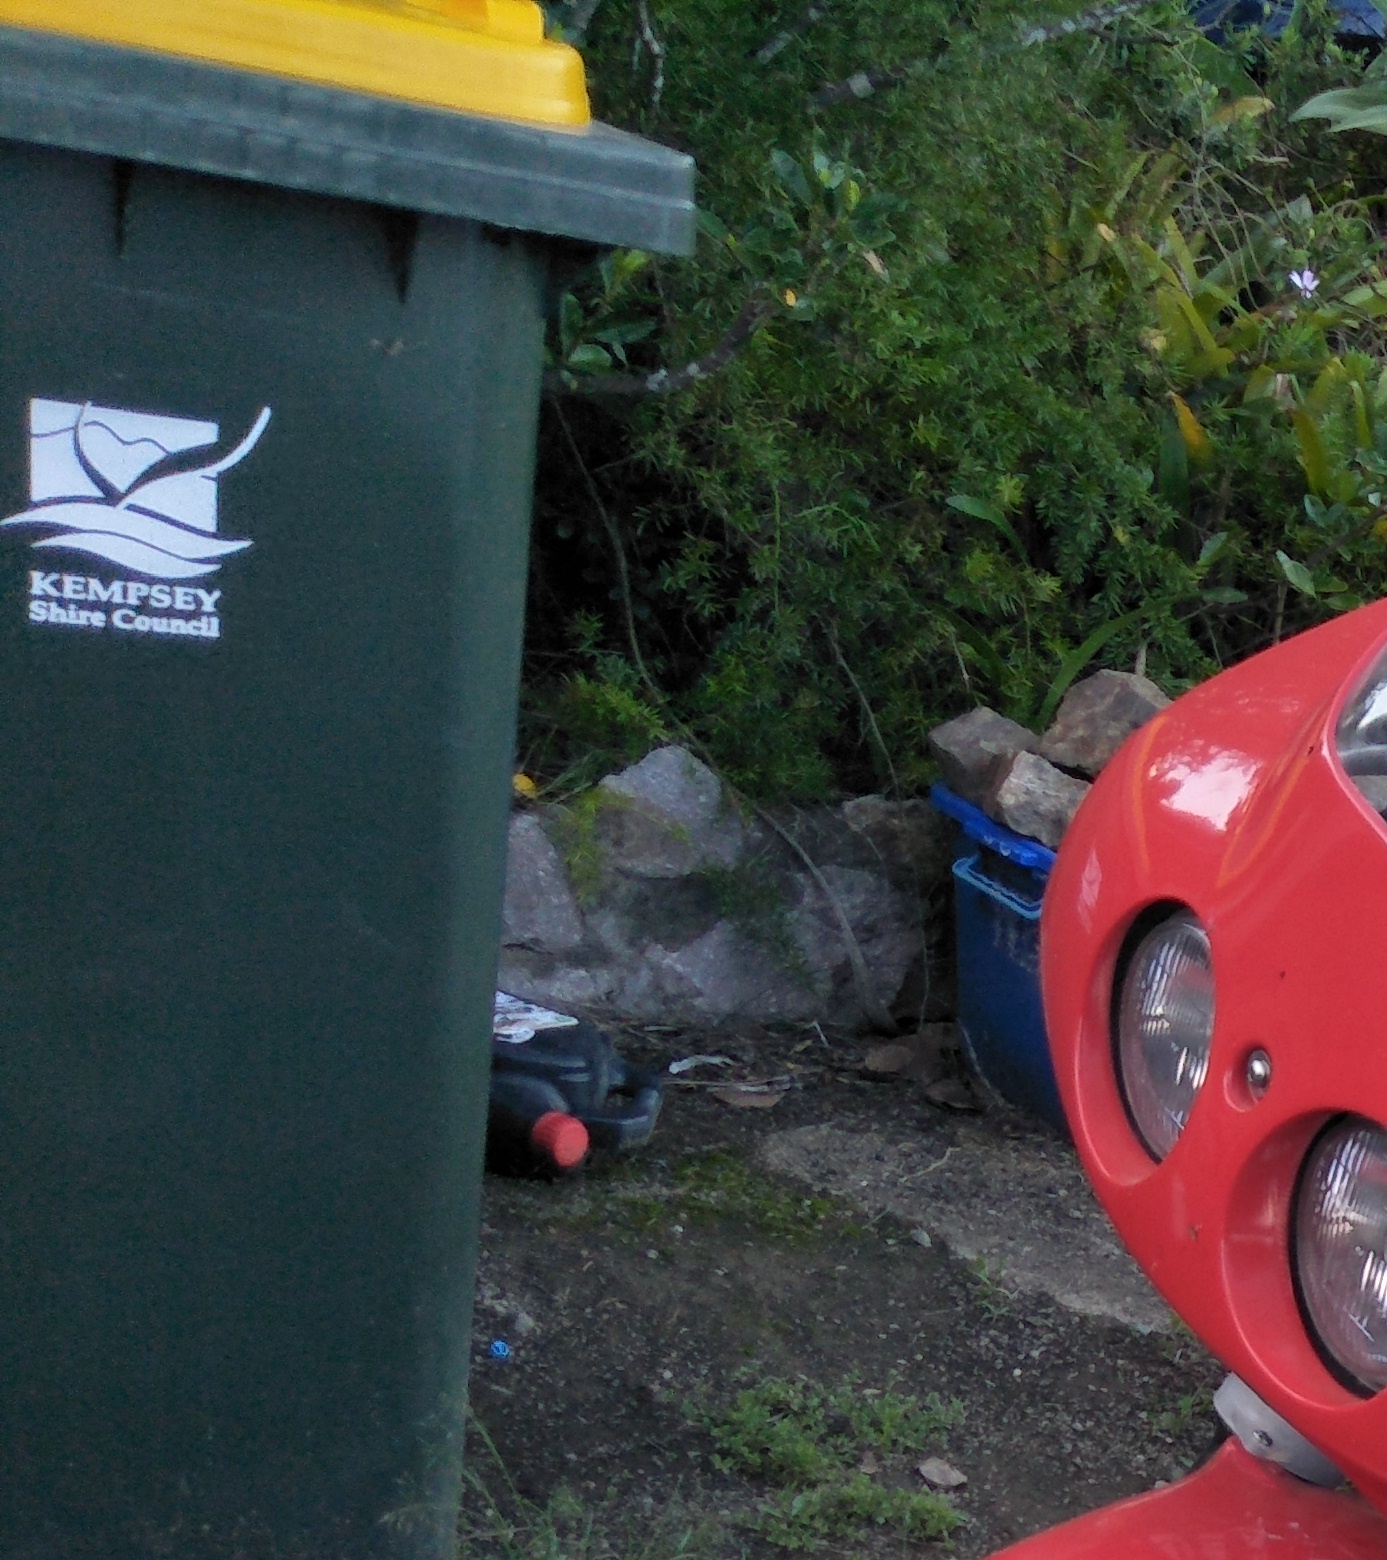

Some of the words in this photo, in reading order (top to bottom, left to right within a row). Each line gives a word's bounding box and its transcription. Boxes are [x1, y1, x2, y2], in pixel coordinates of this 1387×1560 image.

[29, 570, 222, 613] KEMPSEY
[29, 600, 106, 628] Shire
[112, 608, 221, 638] Council
